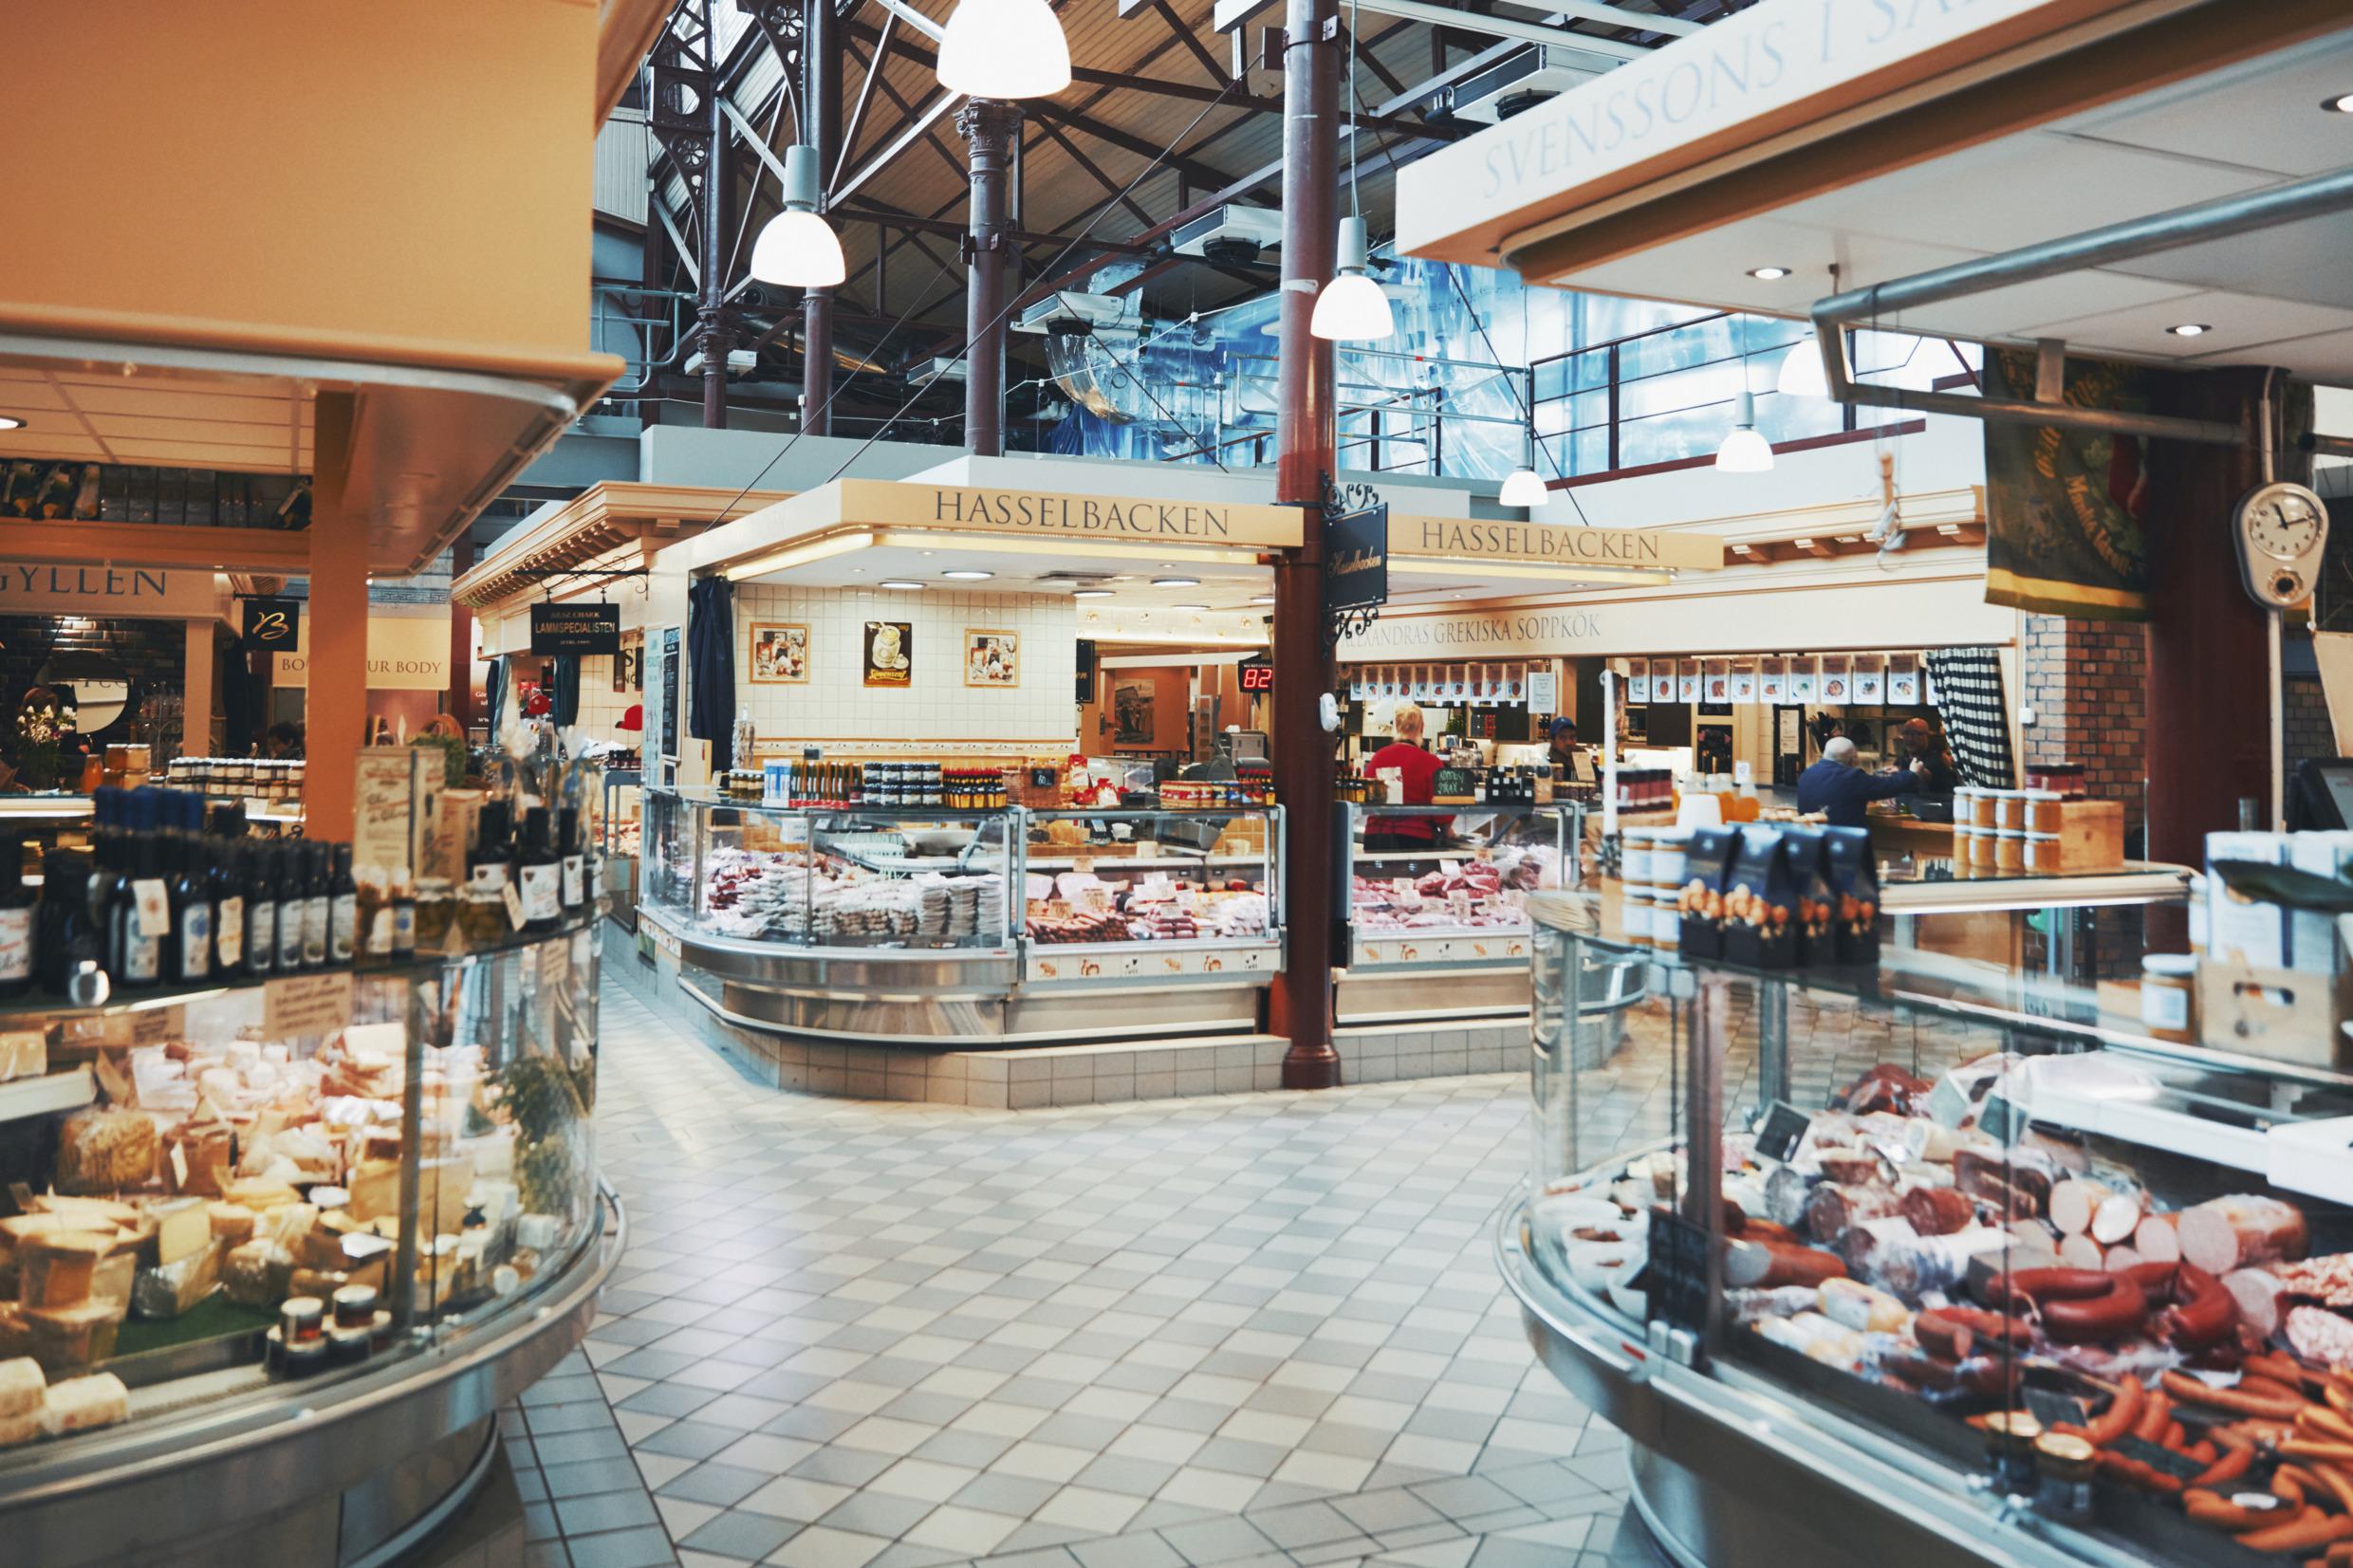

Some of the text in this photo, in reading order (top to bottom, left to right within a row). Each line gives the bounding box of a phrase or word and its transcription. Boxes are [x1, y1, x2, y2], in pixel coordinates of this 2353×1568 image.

[1482, 22, 1788, 199] SVENSSONS
[935, 490, 1230, 536] HASSELBACKEN
[1422, 522, 1659, 560] HASSELBACKEN
[535, 621, 616, 634] LAMMSPECIALISTEN
[1434, 618, 1512, 643] GREKISKA
[1516, 610, 1602, 641] SOPPKÖK
[282, 659, 441, 673] BO UR BODY
[1244, 669, 1272, 688] 82
